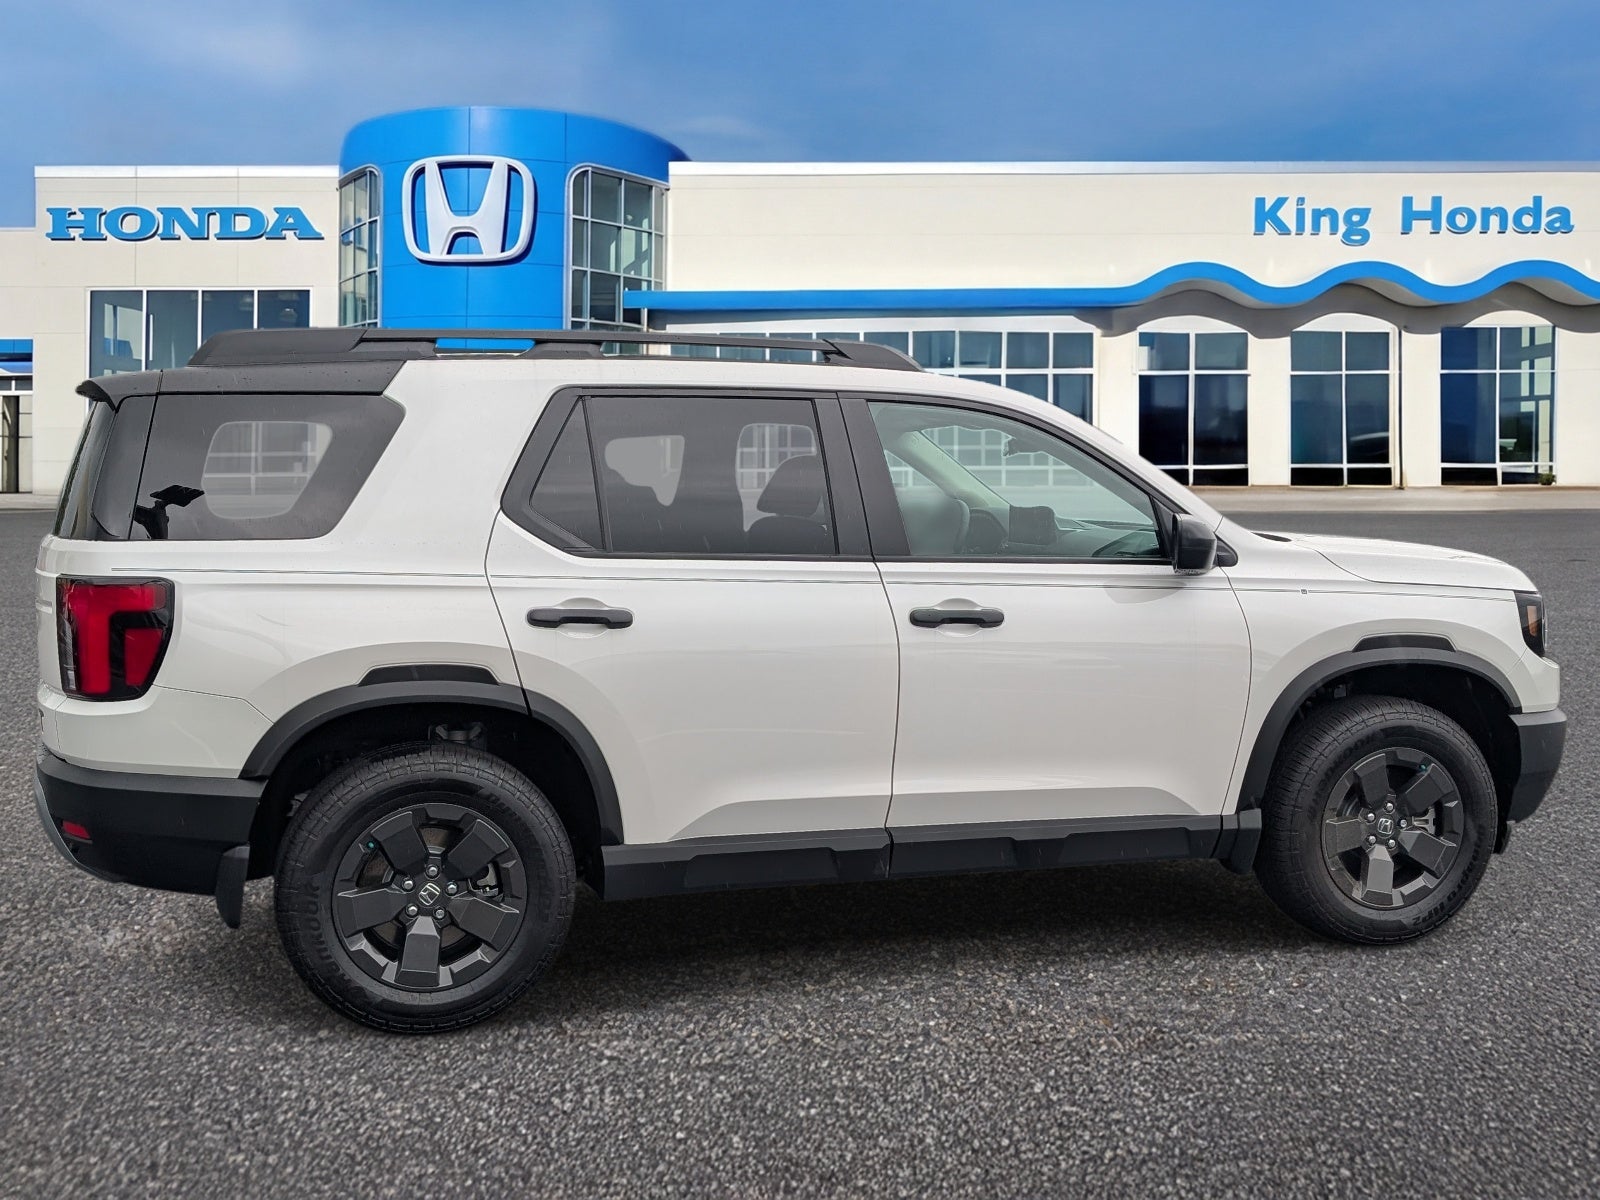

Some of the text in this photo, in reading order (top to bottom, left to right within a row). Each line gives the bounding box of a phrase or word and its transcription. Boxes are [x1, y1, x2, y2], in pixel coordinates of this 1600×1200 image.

[45, 206, 324, 241] HONDA
[1254, 195, 1574, 246] King Honda
